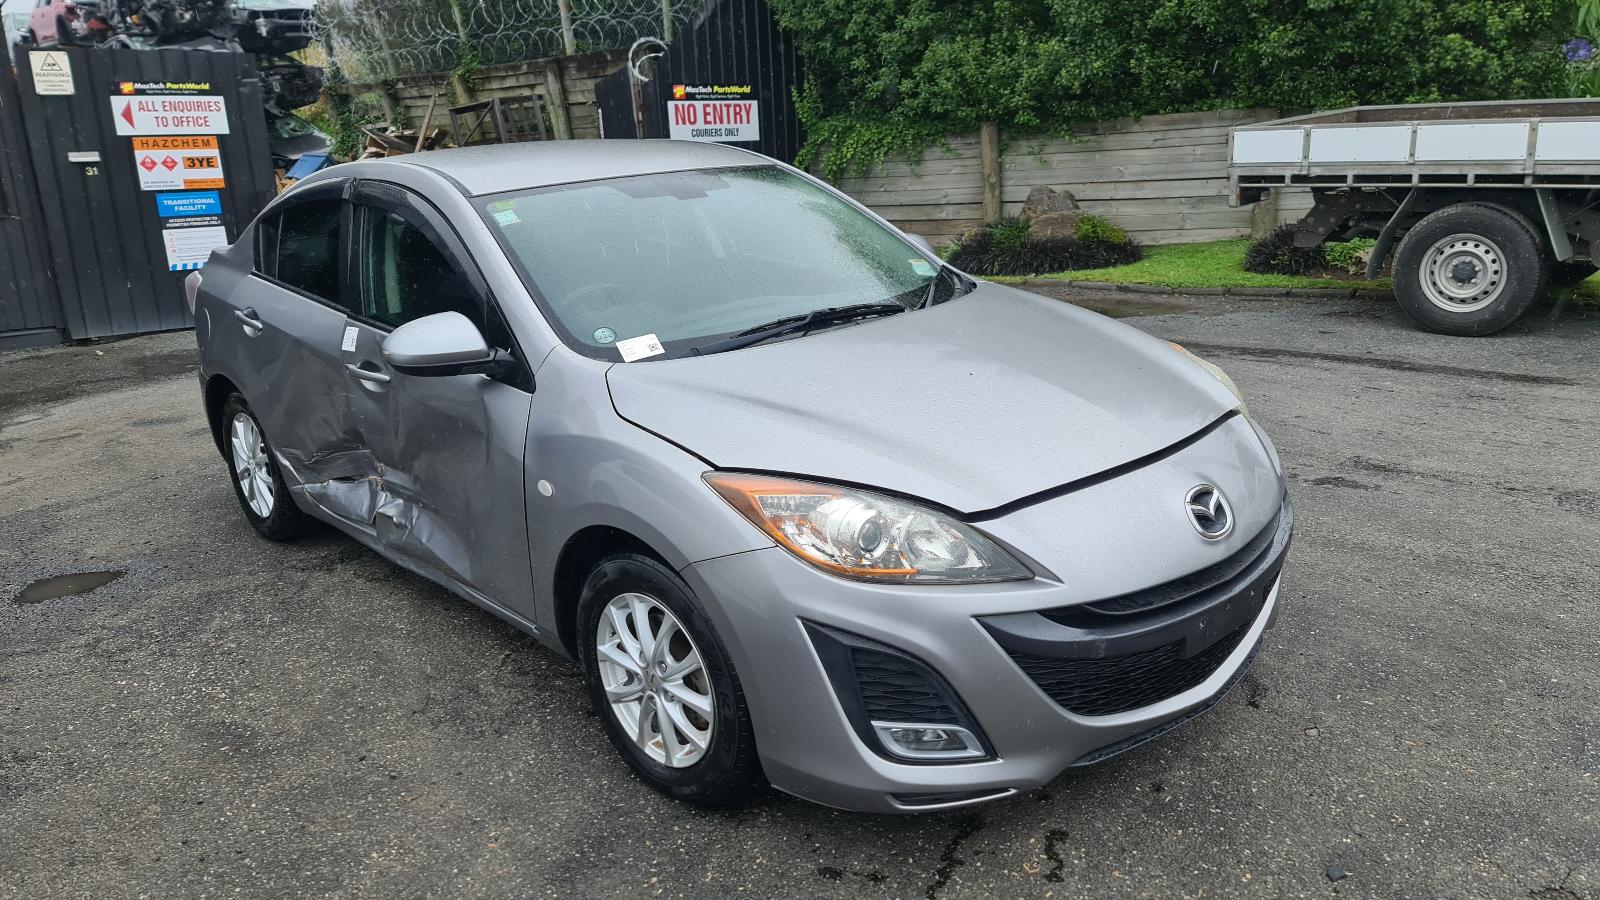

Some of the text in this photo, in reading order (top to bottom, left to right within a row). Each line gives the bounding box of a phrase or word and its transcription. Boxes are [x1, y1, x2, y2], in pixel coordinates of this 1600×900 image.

[713, 85, 750, 93] PartsWorld
[138, 100, 222, 112] ALL ENQUIRIES
[674, 104, 752, 125] NO ENTRY
[154, 116, 210, 128] TO OFFICE
[692, 128, 740, 138] COURIERS ONLY
[140, 138, 210, 148] HAZCHEM
[186, 158, 214, 168] 3YE
[85, 166, 98, 176] 31
